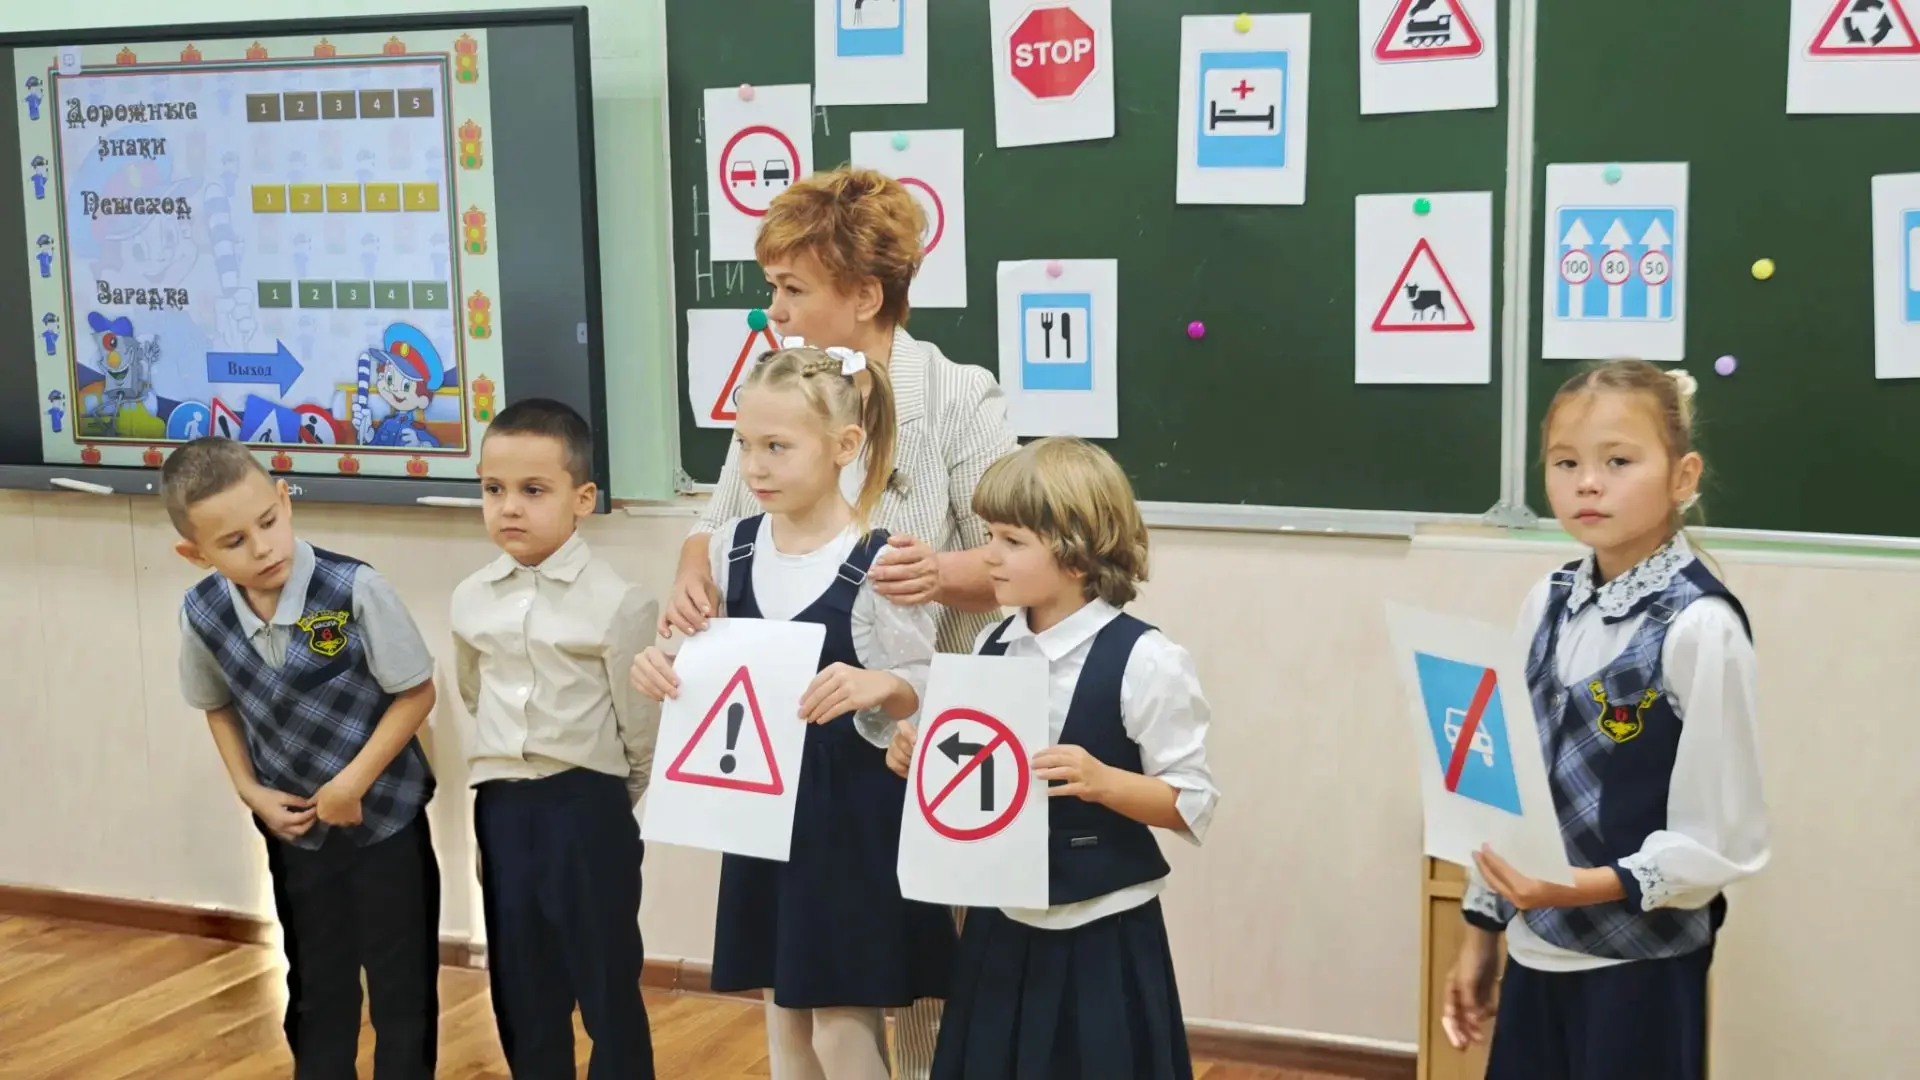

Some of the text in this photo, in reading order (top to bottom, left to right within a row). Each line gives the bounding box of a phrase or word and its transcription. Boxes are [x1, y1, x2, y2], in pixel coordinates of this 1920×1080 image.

[1015, 37, 1092, 68] STOP
[65, 97, 197, 128] Дорожные
[260, 97, 420, 114] 1 2 3 4 5
[80, 190, 192, 220] Пешеход
[266, 190, 425, 204] 1 2 3 4 5
[1565, 260, 1664, 275] 100 80 50
[96, 279, 190, 311] Загадка
[272, 288, 434, 301] 1 2 3 4 5
[227, 360, 272, 377] Выход
